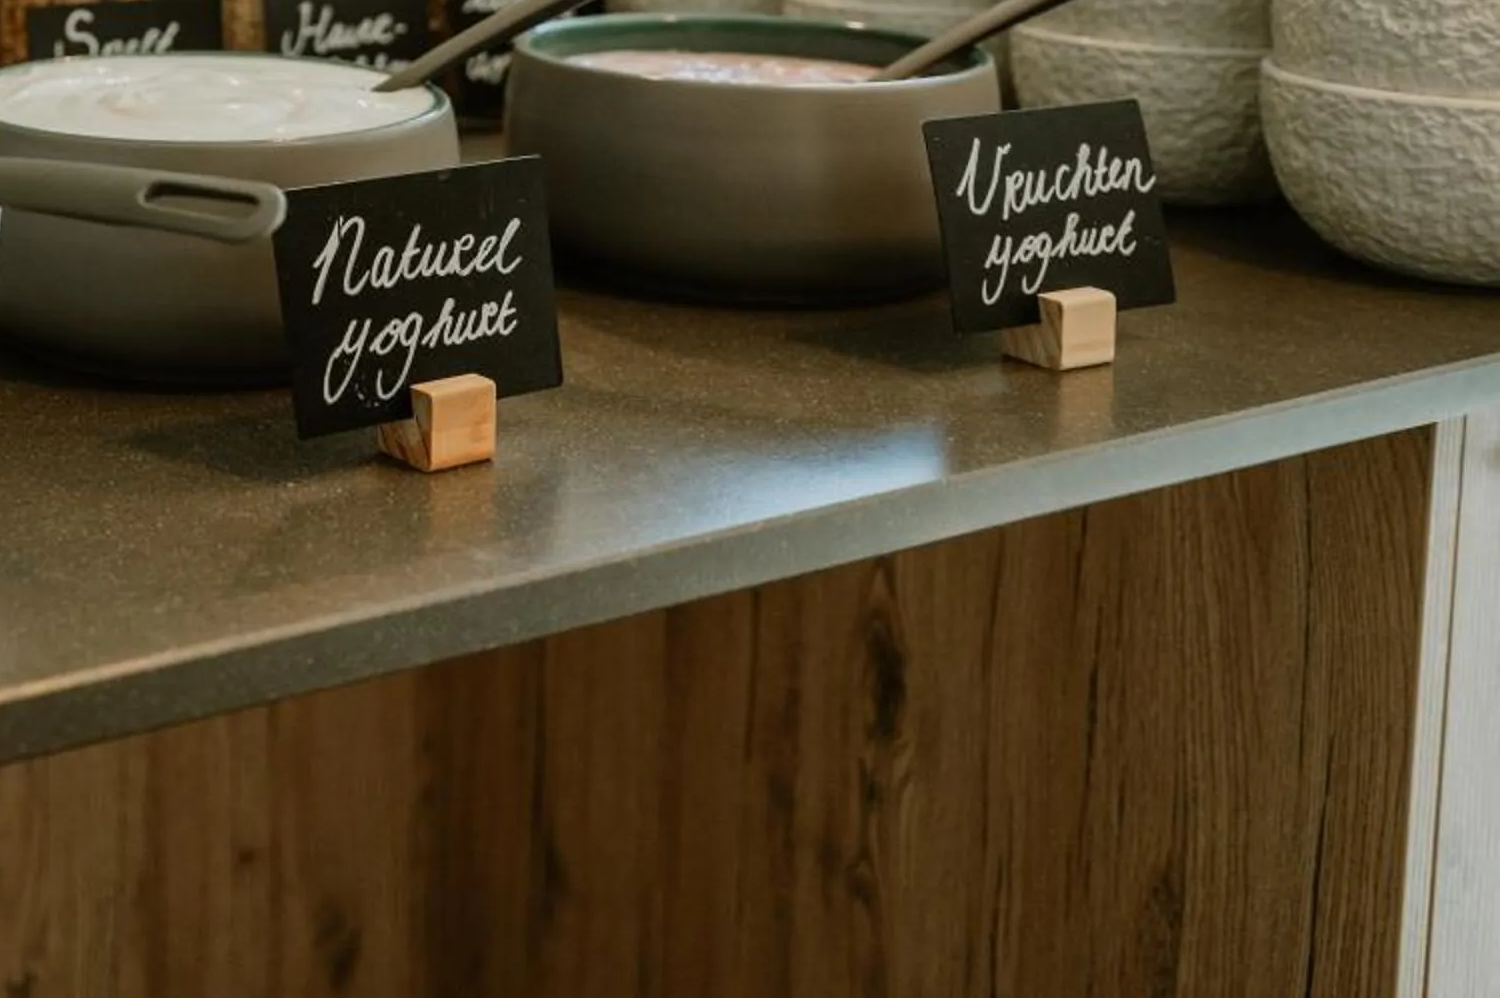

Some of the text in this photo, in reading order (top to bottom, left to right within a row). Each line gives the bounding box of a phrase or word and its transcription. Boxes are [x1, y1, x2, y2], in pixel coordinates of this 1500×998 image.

[956, 137, 1157, 221] Vruchten
[311, 216, 524, 305] Naturel
[981, 209, 1138, 306] yoghurt
[322, 289, 518, 405] yoghurt
